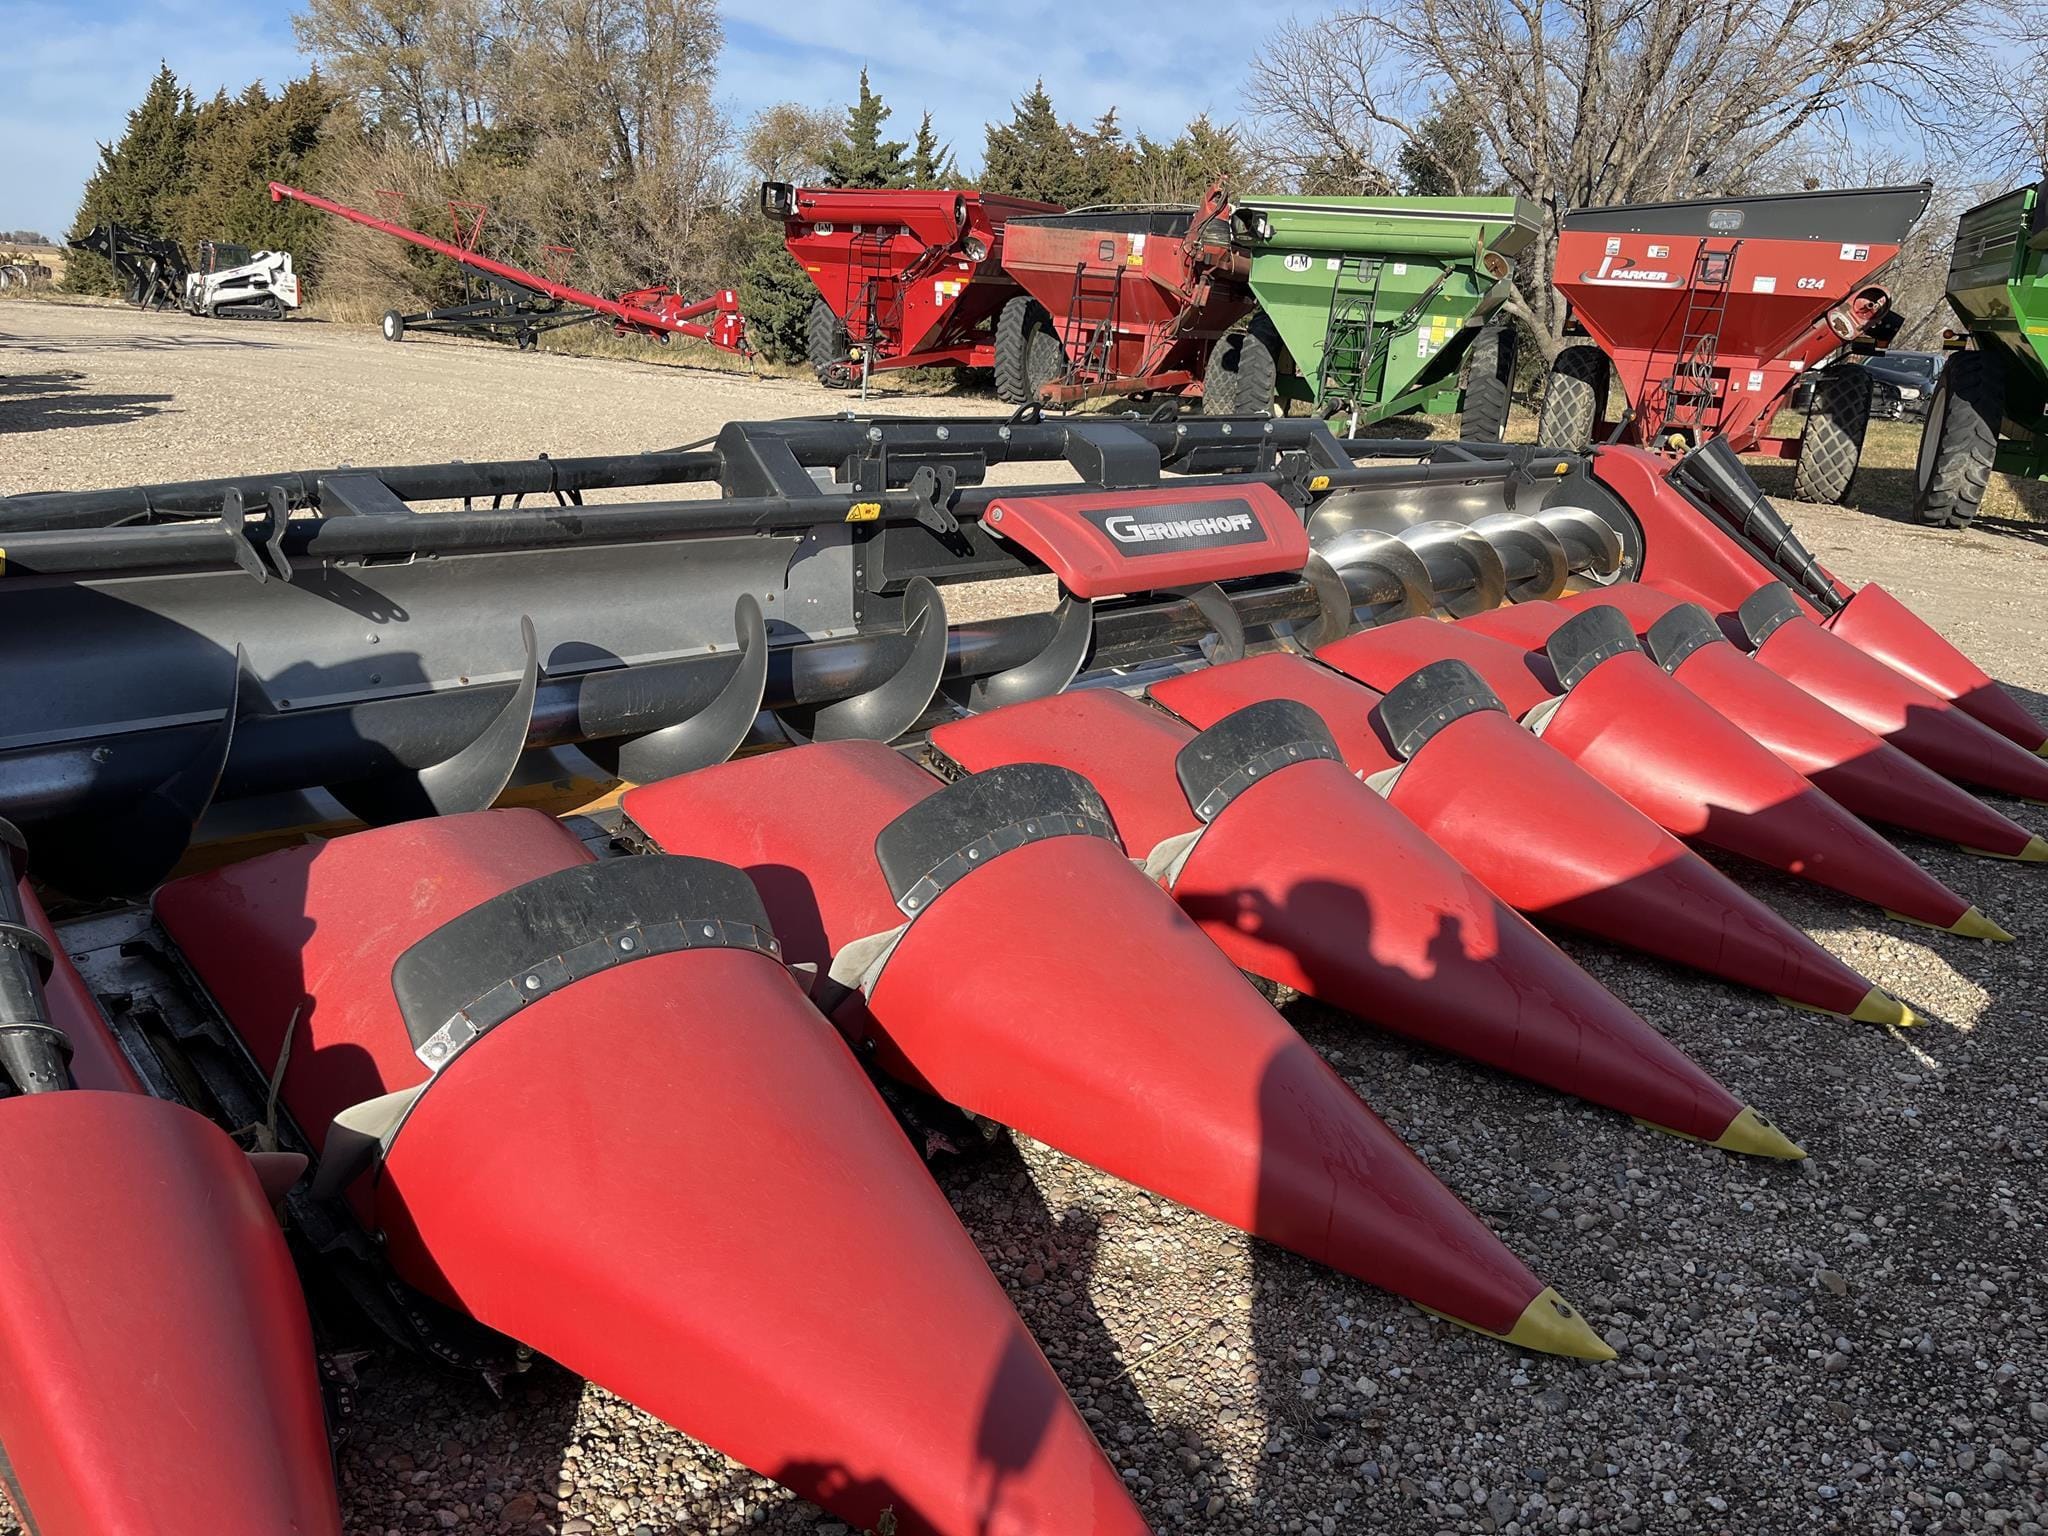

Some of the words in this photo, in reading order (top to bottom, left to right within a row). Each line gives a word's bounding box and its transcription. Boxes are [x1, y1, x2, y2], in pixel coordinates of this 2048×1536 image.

[1611, 269, 1668, 281] PARKER
[1797, 278, 1825, 289] 624
[1105, 513, 1252, 542] GERINGHOFF
